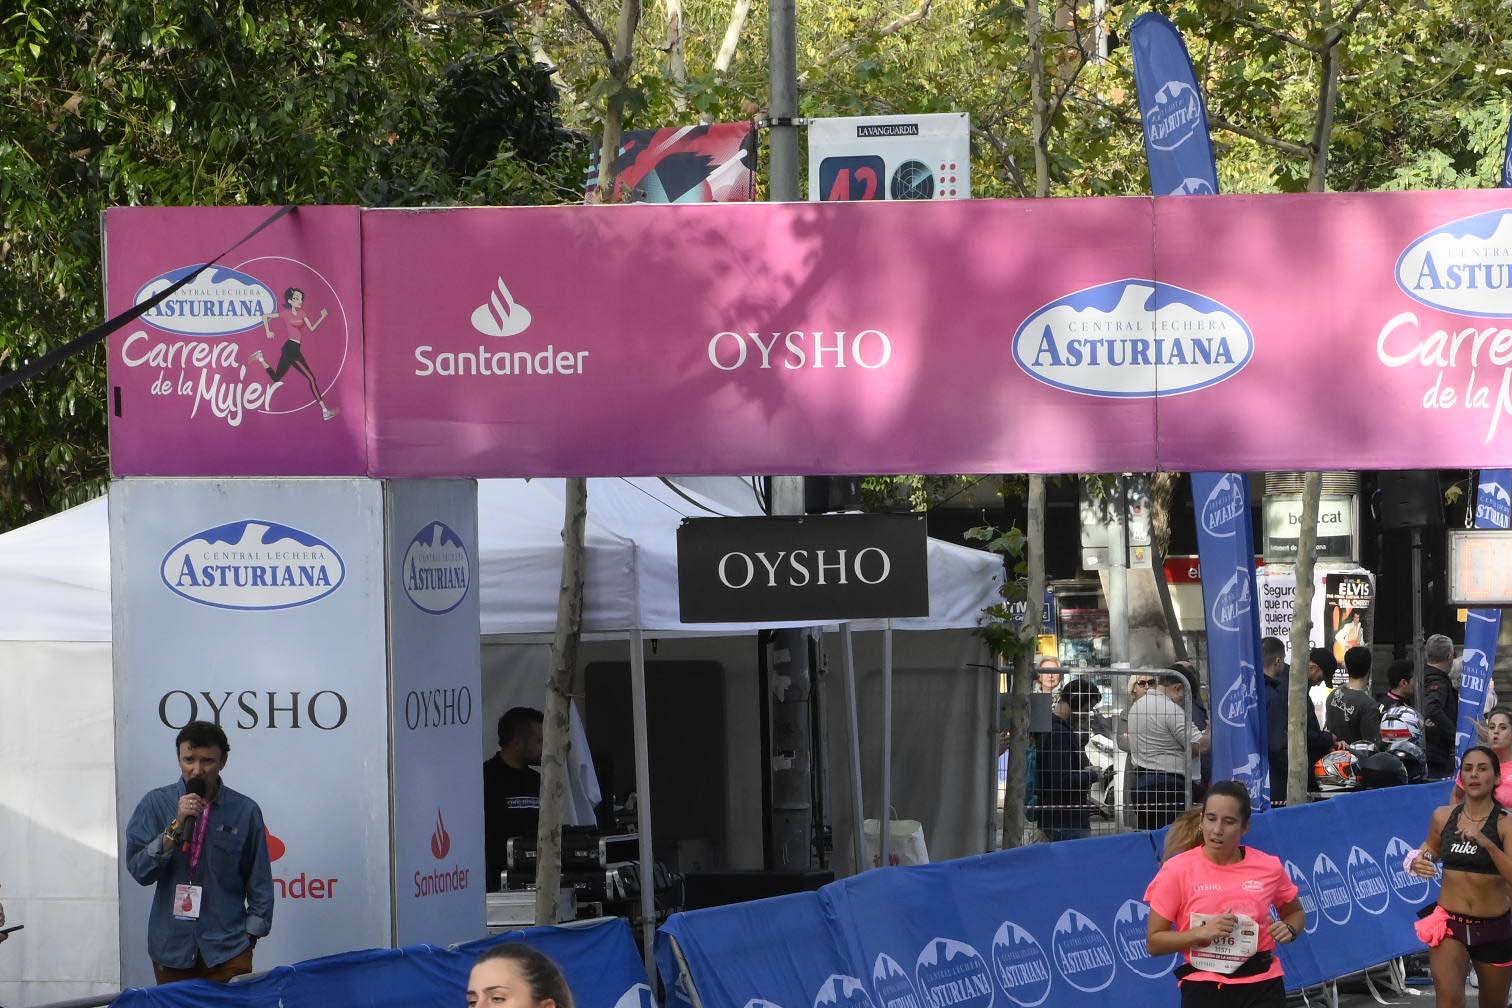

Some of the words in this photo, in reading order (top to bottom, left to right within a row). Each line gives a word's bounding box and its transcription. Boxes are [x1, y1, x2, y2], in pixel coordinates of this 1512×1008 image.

[172, 288, 211, 296] ENTRAL
[1068, 320, 1143, 332] CENTRAL
[121, 331, 240, 369] Carrera
[414, 344, 589, 377] Santander
[708, 329, 892, 371] OYSHO
[1031, 323, 1235, 367] ASTURIANA
[151, 371, 173, 396] de
[178, 372, 193, 397] la
[191, 365, 285, 427] Mujer
[1422, 370, 1457, 409] de
[1465, 370, 1490, 409] la
[176, 553, 332, 587] ASTURIANA
[203, 551, 261, 560] CENTRAL
[267, 551, 326, 560] LECHERA
[717, 547, 892, 589] OYSHO
[408, 555, 466, 591] ASTURIANA
[1338, 582, 1370, 596] ELVIS
[1264, 611, 1293, 624] quiere
[158, 690, 348, 731] OYSHO
[405, 686, 472, 731] OYSHO
[1450, 841, 1478, 855] nike
[415, 864, 470, 898] Santander
[1058, 943, 1113, 975] ASTURIANA
